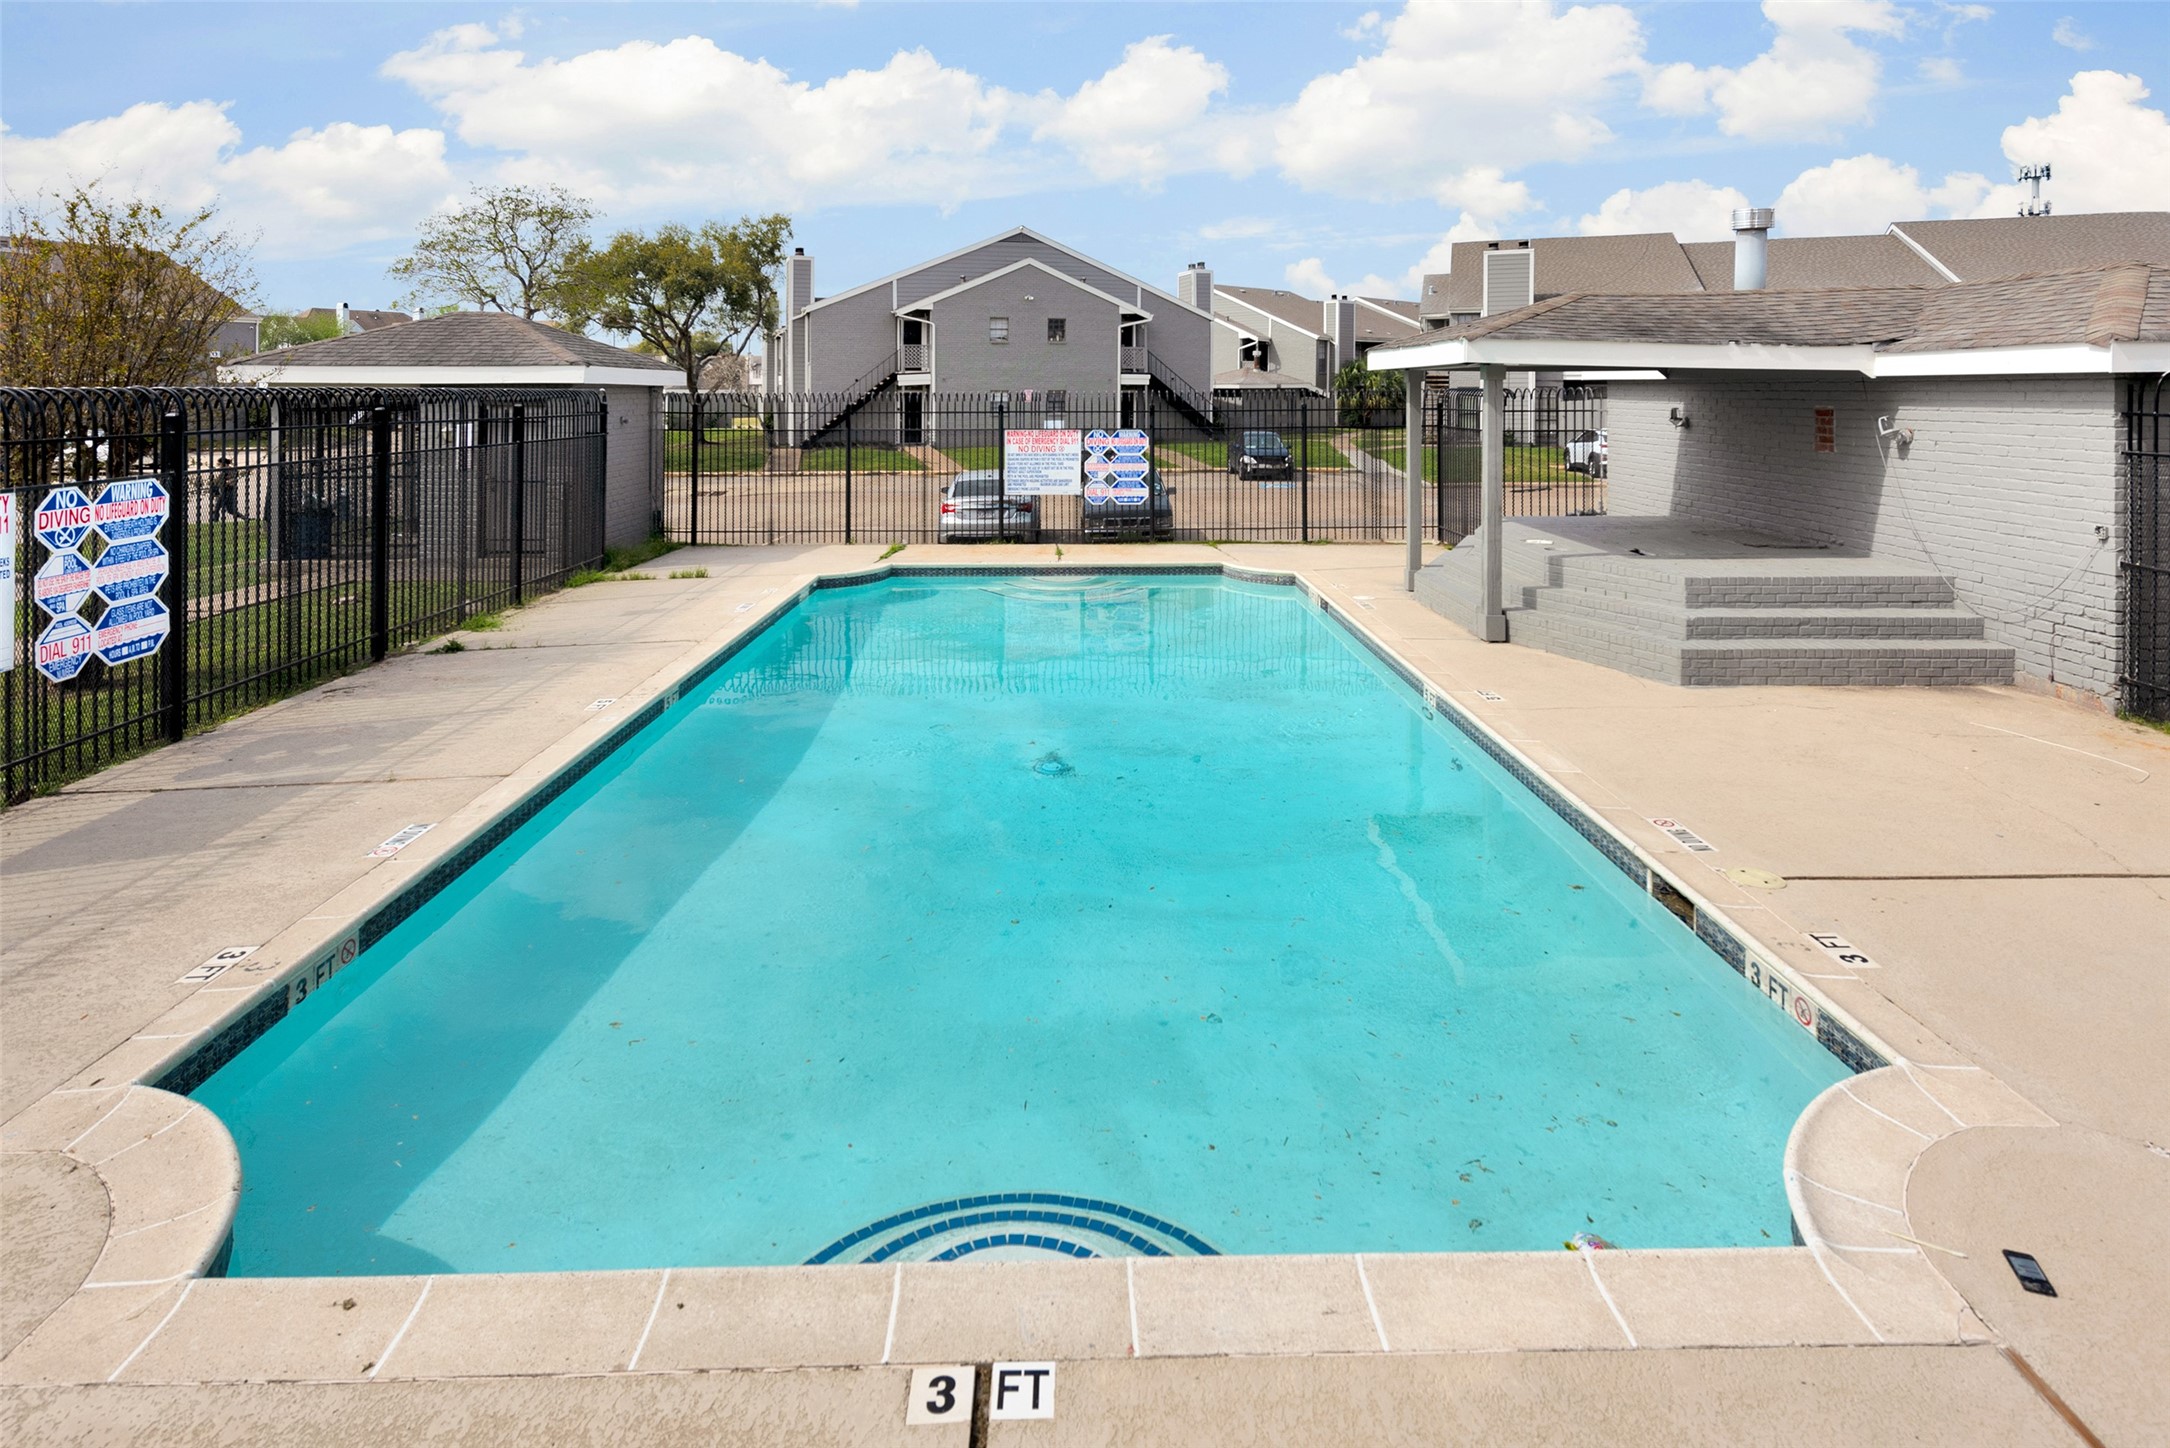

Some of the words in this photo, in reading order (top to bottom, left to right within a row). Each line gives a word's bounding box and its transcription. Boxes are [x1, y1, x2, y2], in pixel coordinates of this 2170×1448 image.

[1094, 430, 1103, 438] NO
[56, 490, 77, 509] NO
[111, 482, 153, 502] WARNING
[0, 495, 9, 513] Y
[95, 505, 104, 521] NO
[106, 500, 138, 520] LIFEGUARD
[141, 499, 149, 514] ON
[151, 497, 166, 513] DUTY
[39, 507, 90, 530] DIVING
[64, 559, 77, 570] POOL
[40, 641, 67, 663] DIAL
[72, 634, 91, 654] 911
[109, 648, 121, 659] HOURS
[49, 655, 82, 672] EMERGENCY
[57, 666, 75, 679] NUMBER
[1809, 934, 1850, 948] FT
[217, 951, 246, 960] 3
[1839, 954, 1869, 963] 3
[185, 965, 226, 981] FT
[295, 977, 307, 1004] 3
[316, 954, 335, 990] FT
[1751, 962, 1761, 988] 3
[1769, 975, 1788, 1010] FT
[927, 1375, 956, 1414] 3
[997, 1370, 1050, 1410] FT
